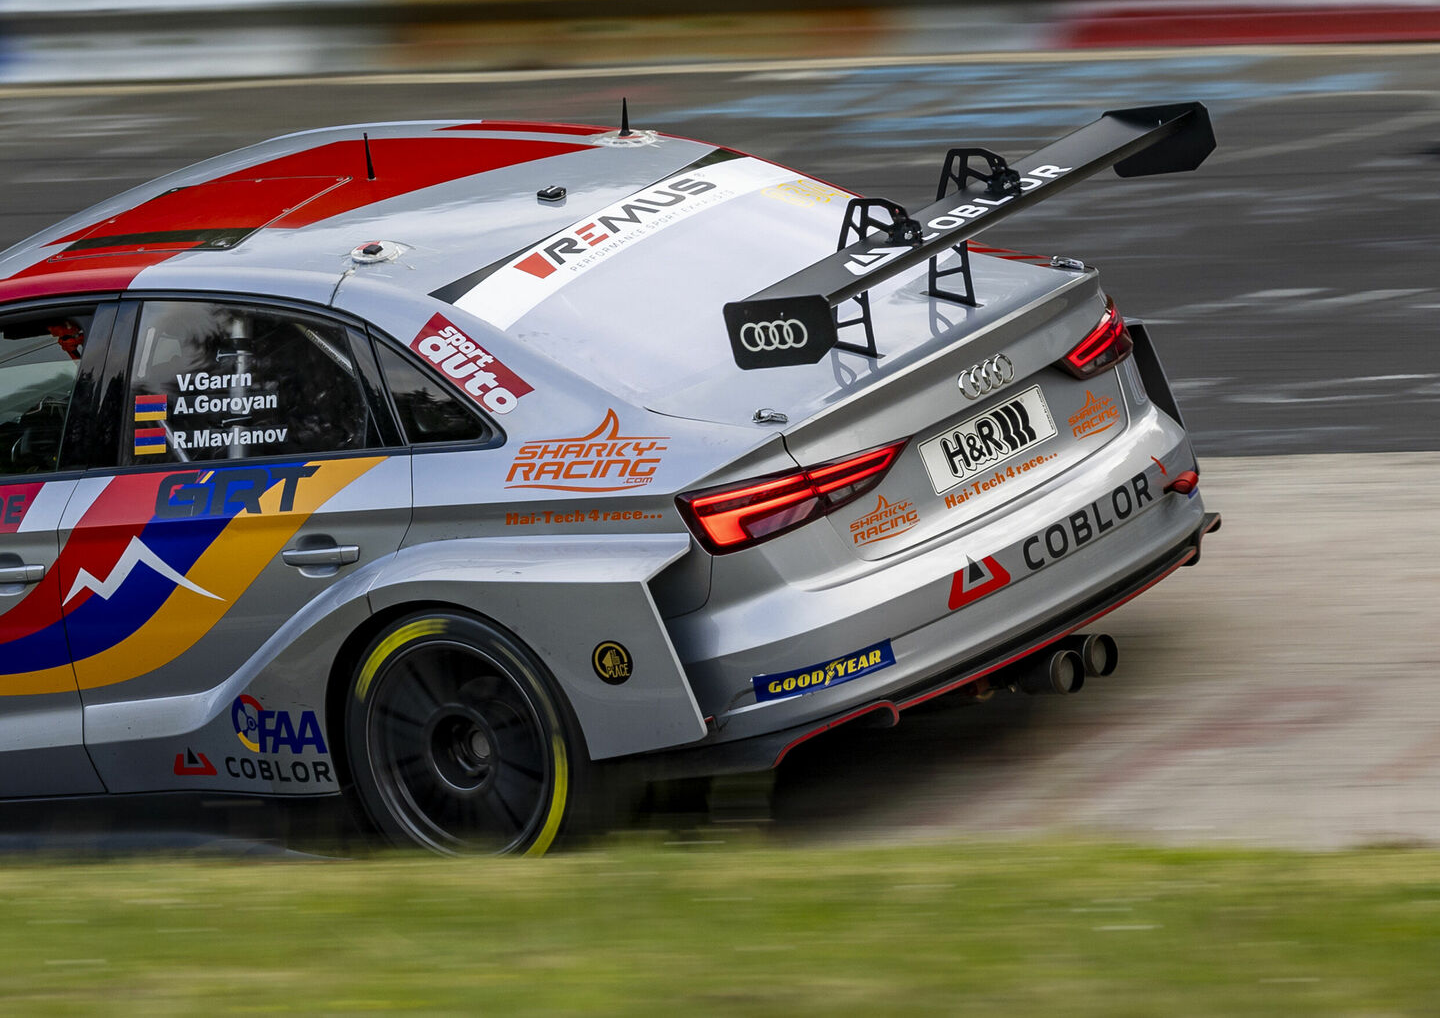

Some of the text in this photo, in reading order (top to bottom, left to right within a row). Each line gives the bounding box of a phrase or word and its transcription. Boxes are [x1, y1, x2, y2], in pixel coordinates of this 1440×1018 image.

[543, 178, 717, 265] REMUS
[569, 228, 645, 272] PERFORMANCE
[646, 211, 677, 230] SPORT
[438, 326, 494, 368] sport
[176, 372, 252, 392] V.Garrn
[418, 335, 518, 414] auto
[174, 394, 277, 415] A.Goroyan
[1072, 405, 1118, 437] RACING
[173, 428, 288, 449] R.Mavlanov
[941, 418, 1007, 476] H&R
[157, 464, 321, 518] GRT
[505, 458, 662, 482] RACING
[945, 452, 1057, 509] Hai-Tech 4 race...
[505, 509, 663, 526] Hai-Tech 4 race...
[854, 510, 917, 544] RACING
[1023, 472, 1153, 570] COBLOR
[257, 710, 328, 754] FAA
[225, 756, 333, 783] COBLOR
